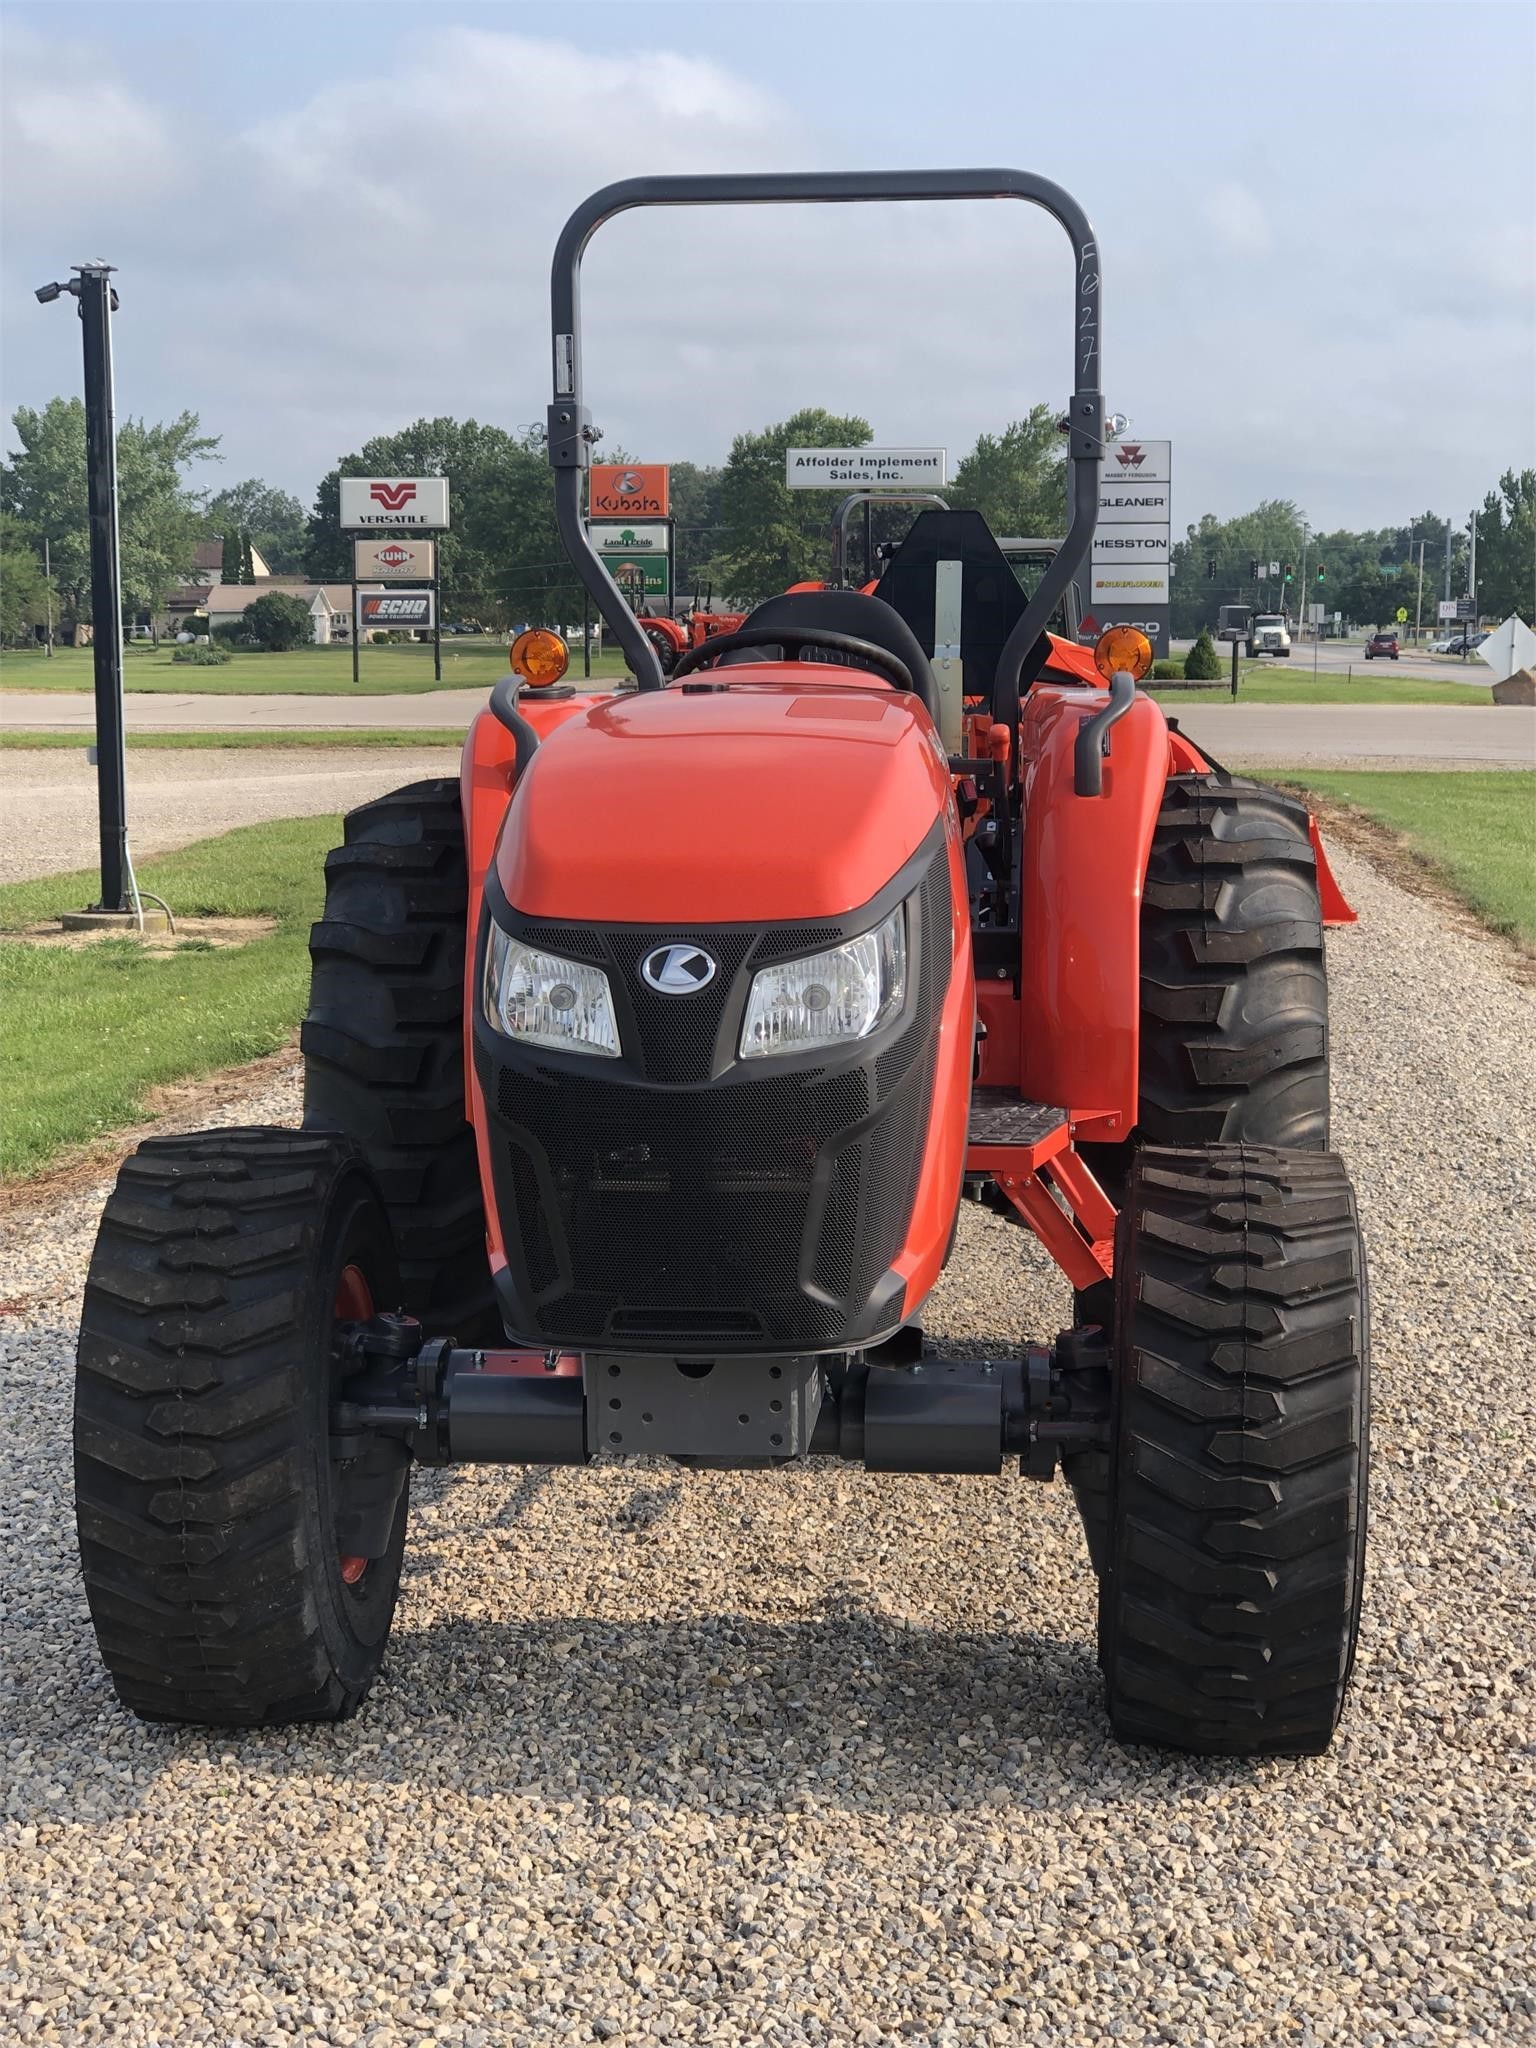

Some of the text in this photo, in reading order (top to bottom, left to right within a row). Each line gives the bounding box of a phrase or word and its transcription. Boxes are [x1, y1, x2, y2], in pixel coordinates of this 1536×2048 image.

[795, 456, 938, 469] Affolder Implement
[829, 469, 904, 481] Sales, Inc.
[596, 495, 660, 511] Kubota
[1099, 497, 1164, 507] GLEANER
[359, 515, 429, 524] VERSATILE
[603, 538, 653, 546] Land Pride
[1094, 539, 1167, 548] HESSTON
[378, 551, 410, 561] KUHN
[377, 599, 428, 614] ECHO
[1102, 621, 1160, 633] ACO
